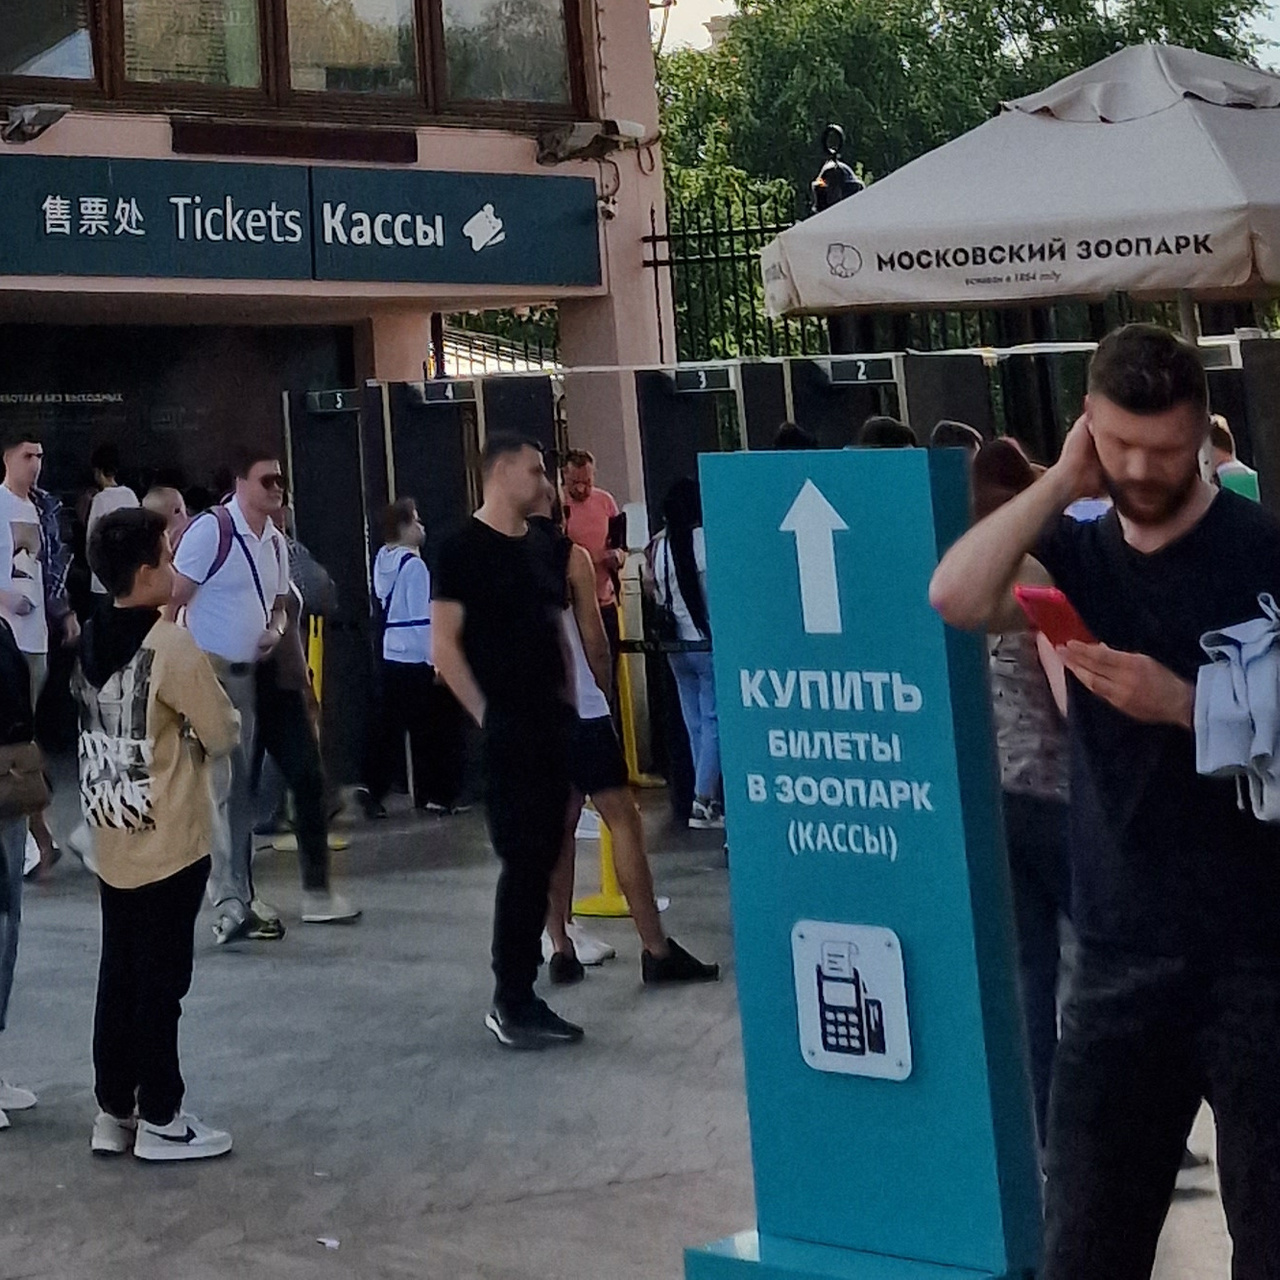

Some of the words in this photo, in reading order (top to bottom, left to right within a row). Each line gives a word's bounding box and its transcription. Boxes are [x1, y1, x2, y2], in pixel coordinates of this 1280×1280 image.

[41, 195, 146, 235] 售票处
[169, 195, 303, 242] Tickets
[323, 202, 444, 247] Кассы
[877, 238, 1066, 272] МОСКОВСКИЙ
[1077, 234, 1214, 259] ЗООПАРК
[698, 371, 707, 389] 3
[856, 360, 867, 380] 2
[335, 392, 343, 408] 5
[445, 383, 454, 400] 4
[740, 669, 922, 712] КУПИТЬ
[768, 729, 902, 762] БИЛЕТЫ
[747, 773, 767, 802] В
[775, 775, 933, 811] ЗООПАРК
[788, 819, 898, 862] (КАССЫ)
